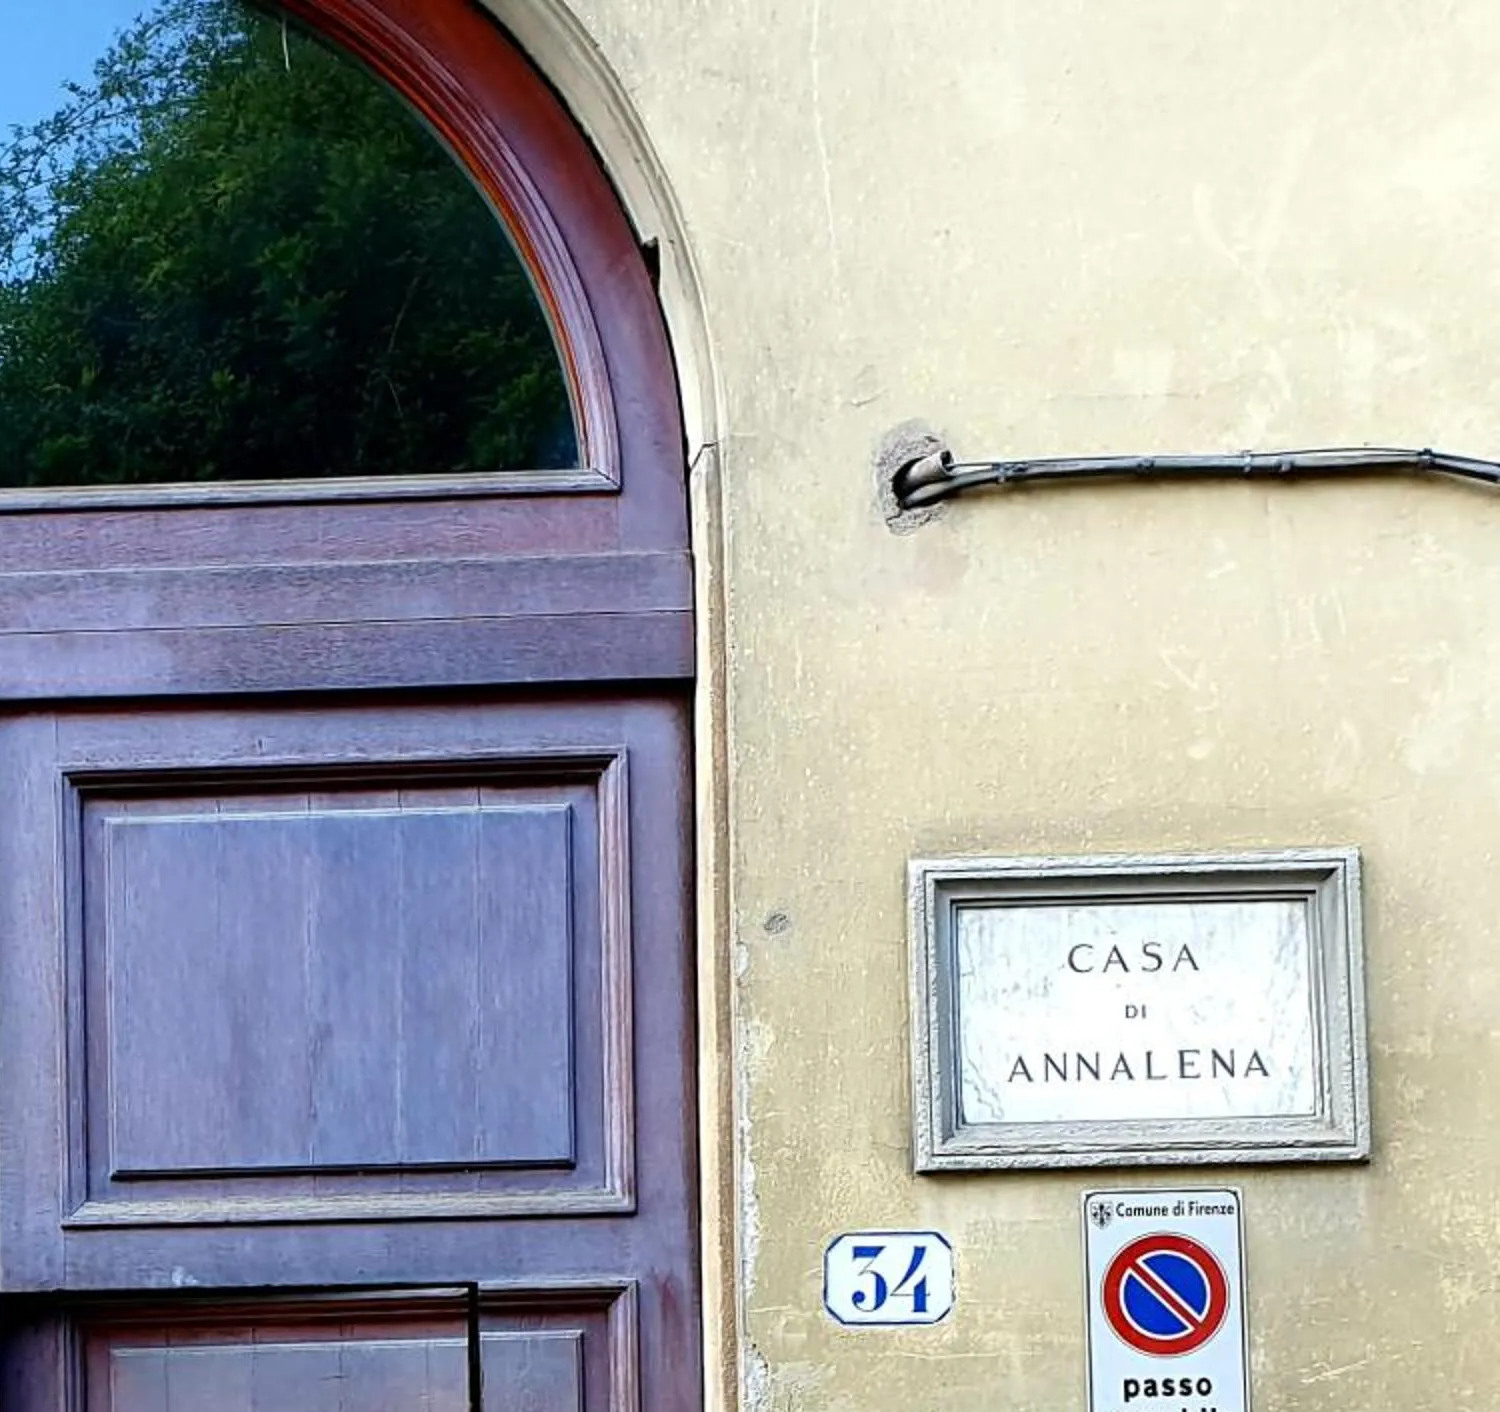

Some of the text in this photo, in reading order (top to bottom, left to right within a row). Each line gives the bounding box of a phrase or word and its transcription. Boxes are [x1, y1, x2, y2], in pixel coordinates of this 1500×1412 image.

[1067, 942, 1200, 974] CASA
[1124, 1004, 1147, 1019] DI
[1008, 1048, 1270, 1083] ANNALENA
[1116, 1200, 1235, 1217] Comune di Firenze
[851, 1245, 931, 1313] 34
[1123, 1376, 1213, 1402] passo
